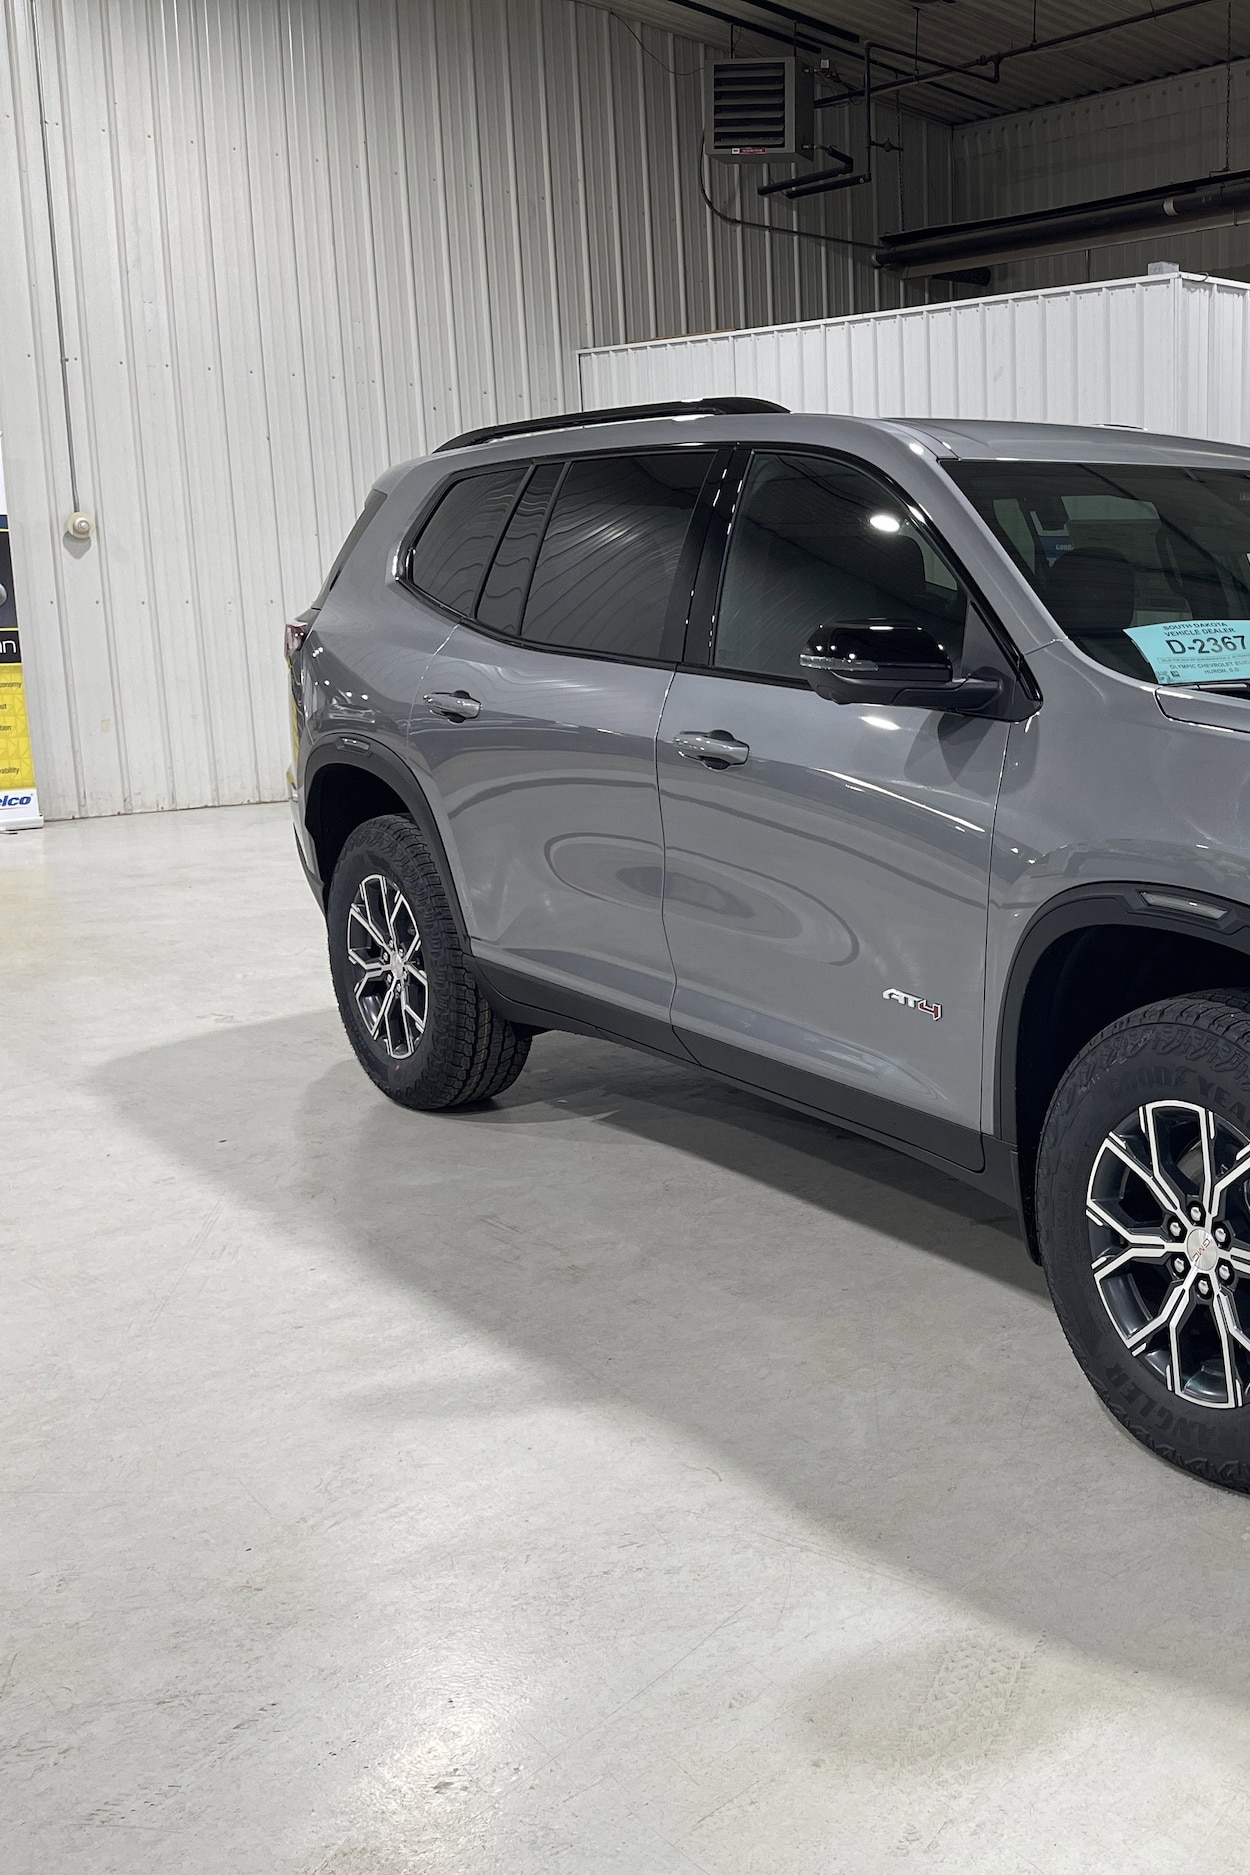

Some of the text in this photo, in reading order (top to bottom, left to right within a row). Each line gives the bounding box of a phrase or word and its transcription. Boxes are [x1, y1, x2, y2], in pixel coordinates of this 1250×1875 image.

[1163, 623, 1193, 631] SOUTH
[1164, 627, 1236, 637] VEHICLE DEALER
[1165, 635, 1247, 655] D-2367
[1197, 661, 1233, 669] CHEVROLET
[882, 988, 942, 1021] AT4
[1192, 1238, 1211, 1262] GMC
